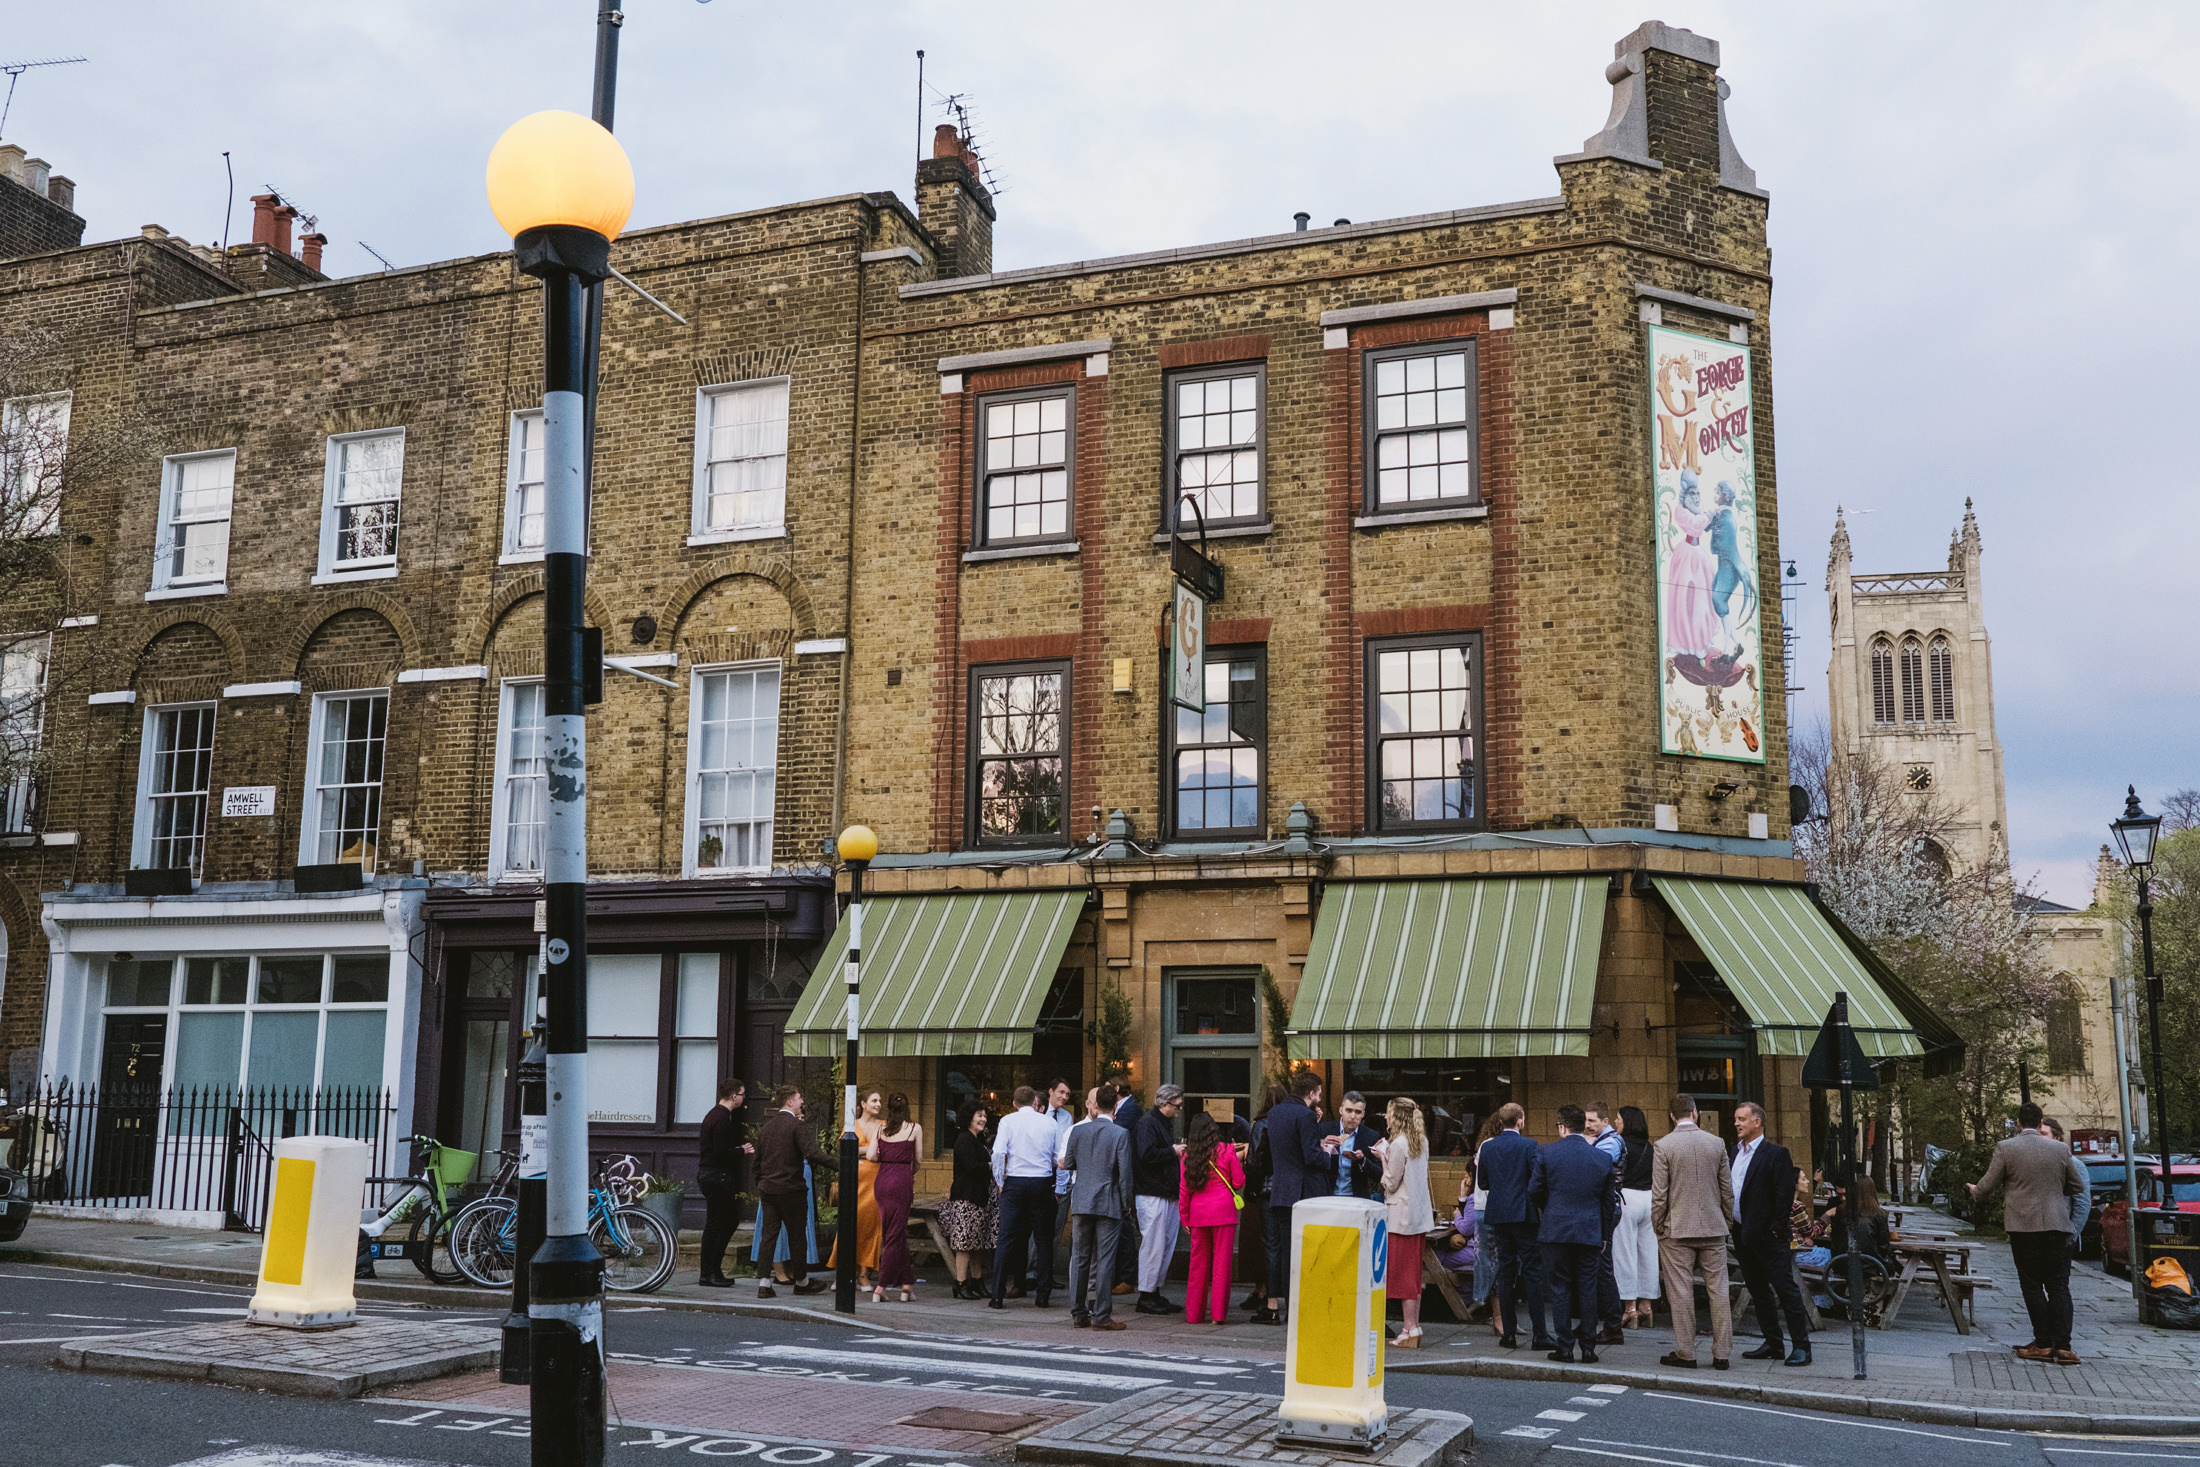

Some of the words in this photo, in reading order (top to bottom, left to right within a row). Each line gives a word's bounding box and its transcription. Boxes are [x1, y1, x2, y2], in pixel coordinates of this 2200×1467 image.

[1693, 350, 1709, 362] THE
[1711, 386, 1731, 420] &
[1675, 698, 1702, 716] PUBLIC
[1726, 705, 1751, 719] HOUSE
[228, 793, 264, 803] AMWELL
[227, 804, 259, 815] STREET
[131, 1043, 141, 1053] 72
[388, 1194, 418, 1221] Lime
[653, 1356, 871, 1381] LOOK
[880, 1377, 1079, 1398] LEFT
[620, 1429, 894, 1467] LOOK
